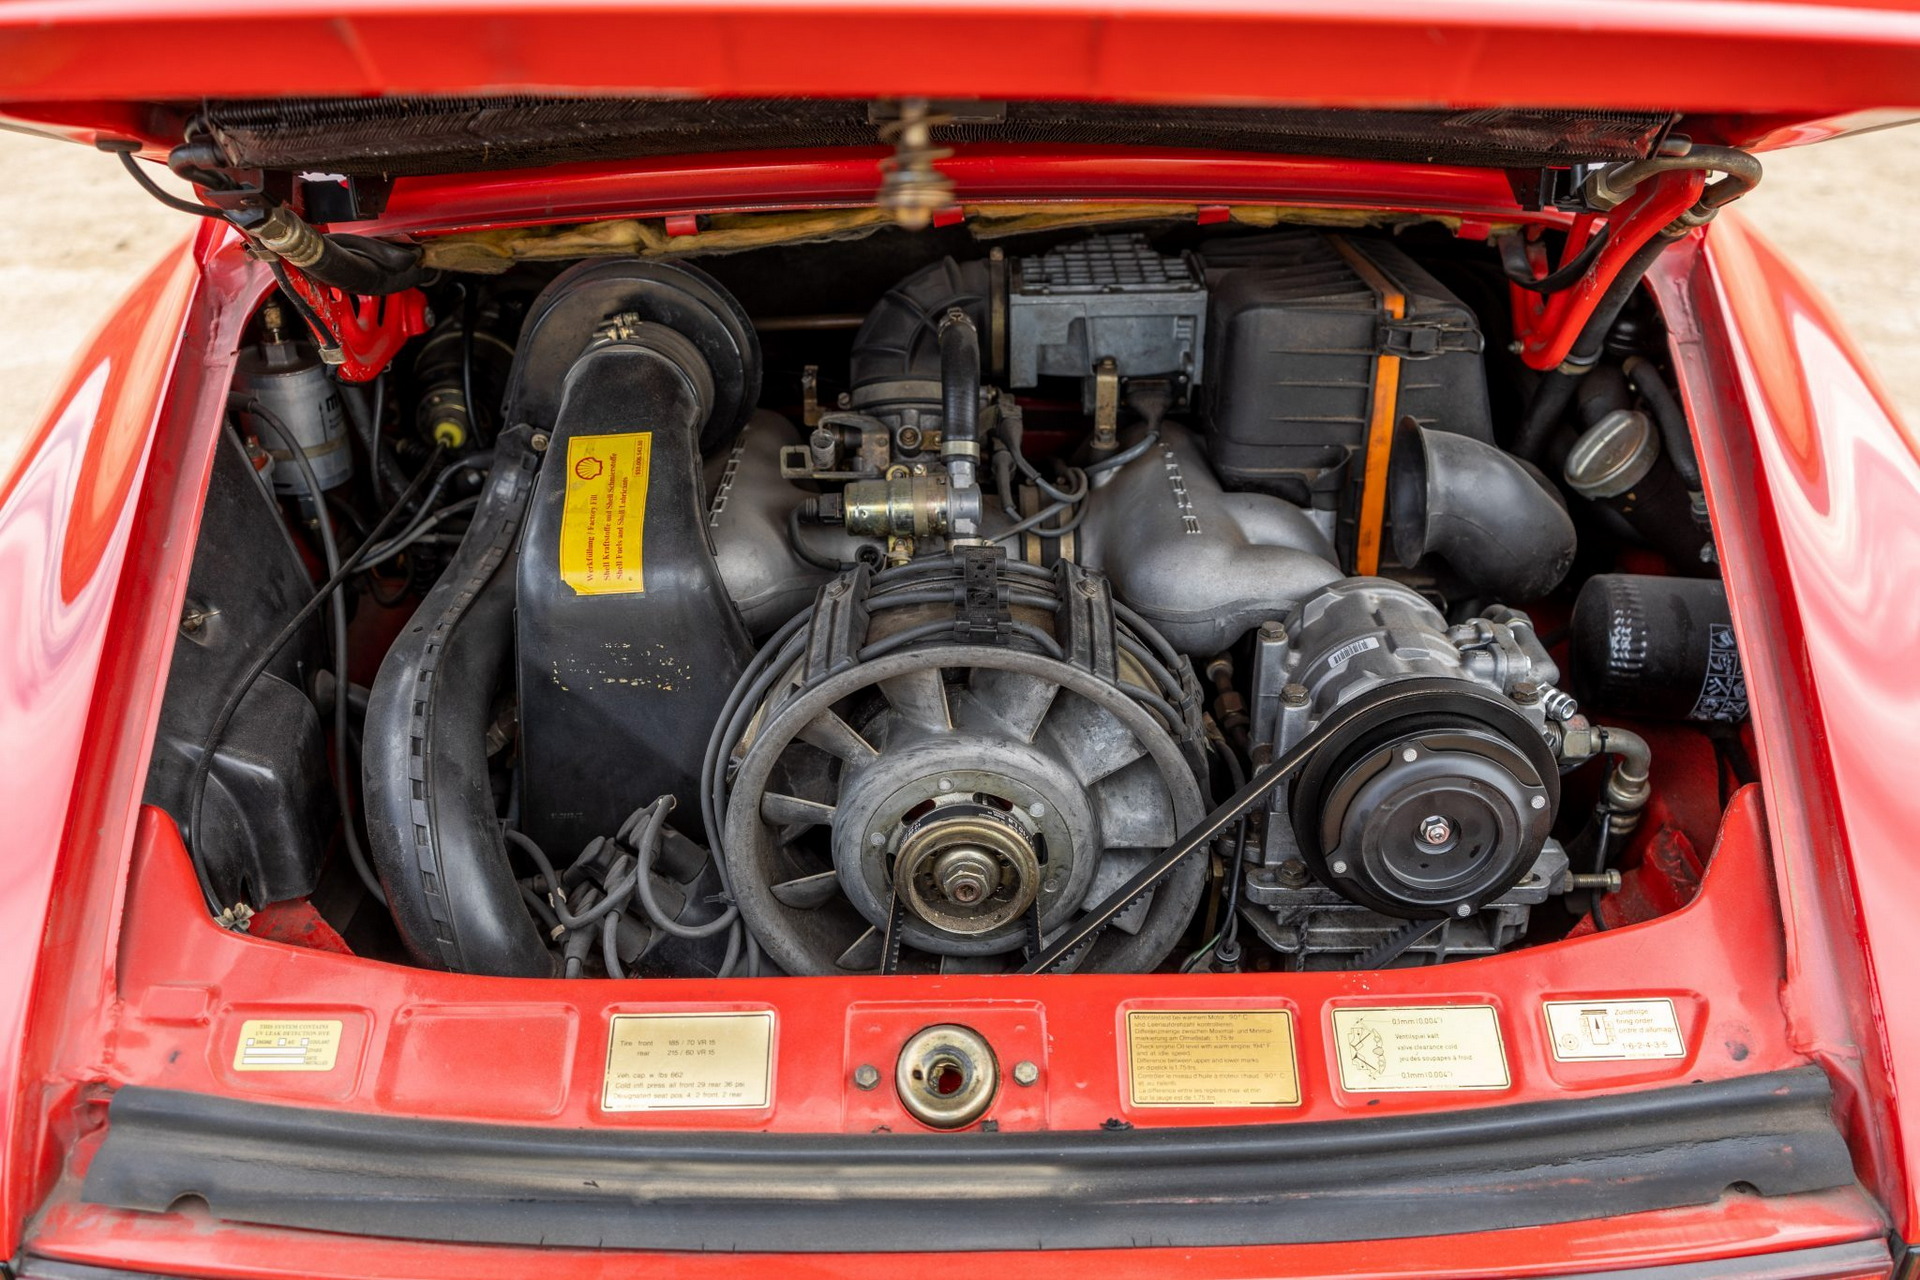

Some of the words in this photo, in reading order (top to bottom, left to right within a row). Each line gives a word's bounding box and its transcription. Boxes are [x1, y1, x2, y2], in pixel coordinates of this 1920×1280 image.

[590, 494, 598, 505] Fill
[603, 523, 612, 559] Kraftstoffe
[608, 453, 617, 492] Schmierstoffe
[620, 477, 628, 508] Lubricants
[588, 507, 597, 530] Factory
